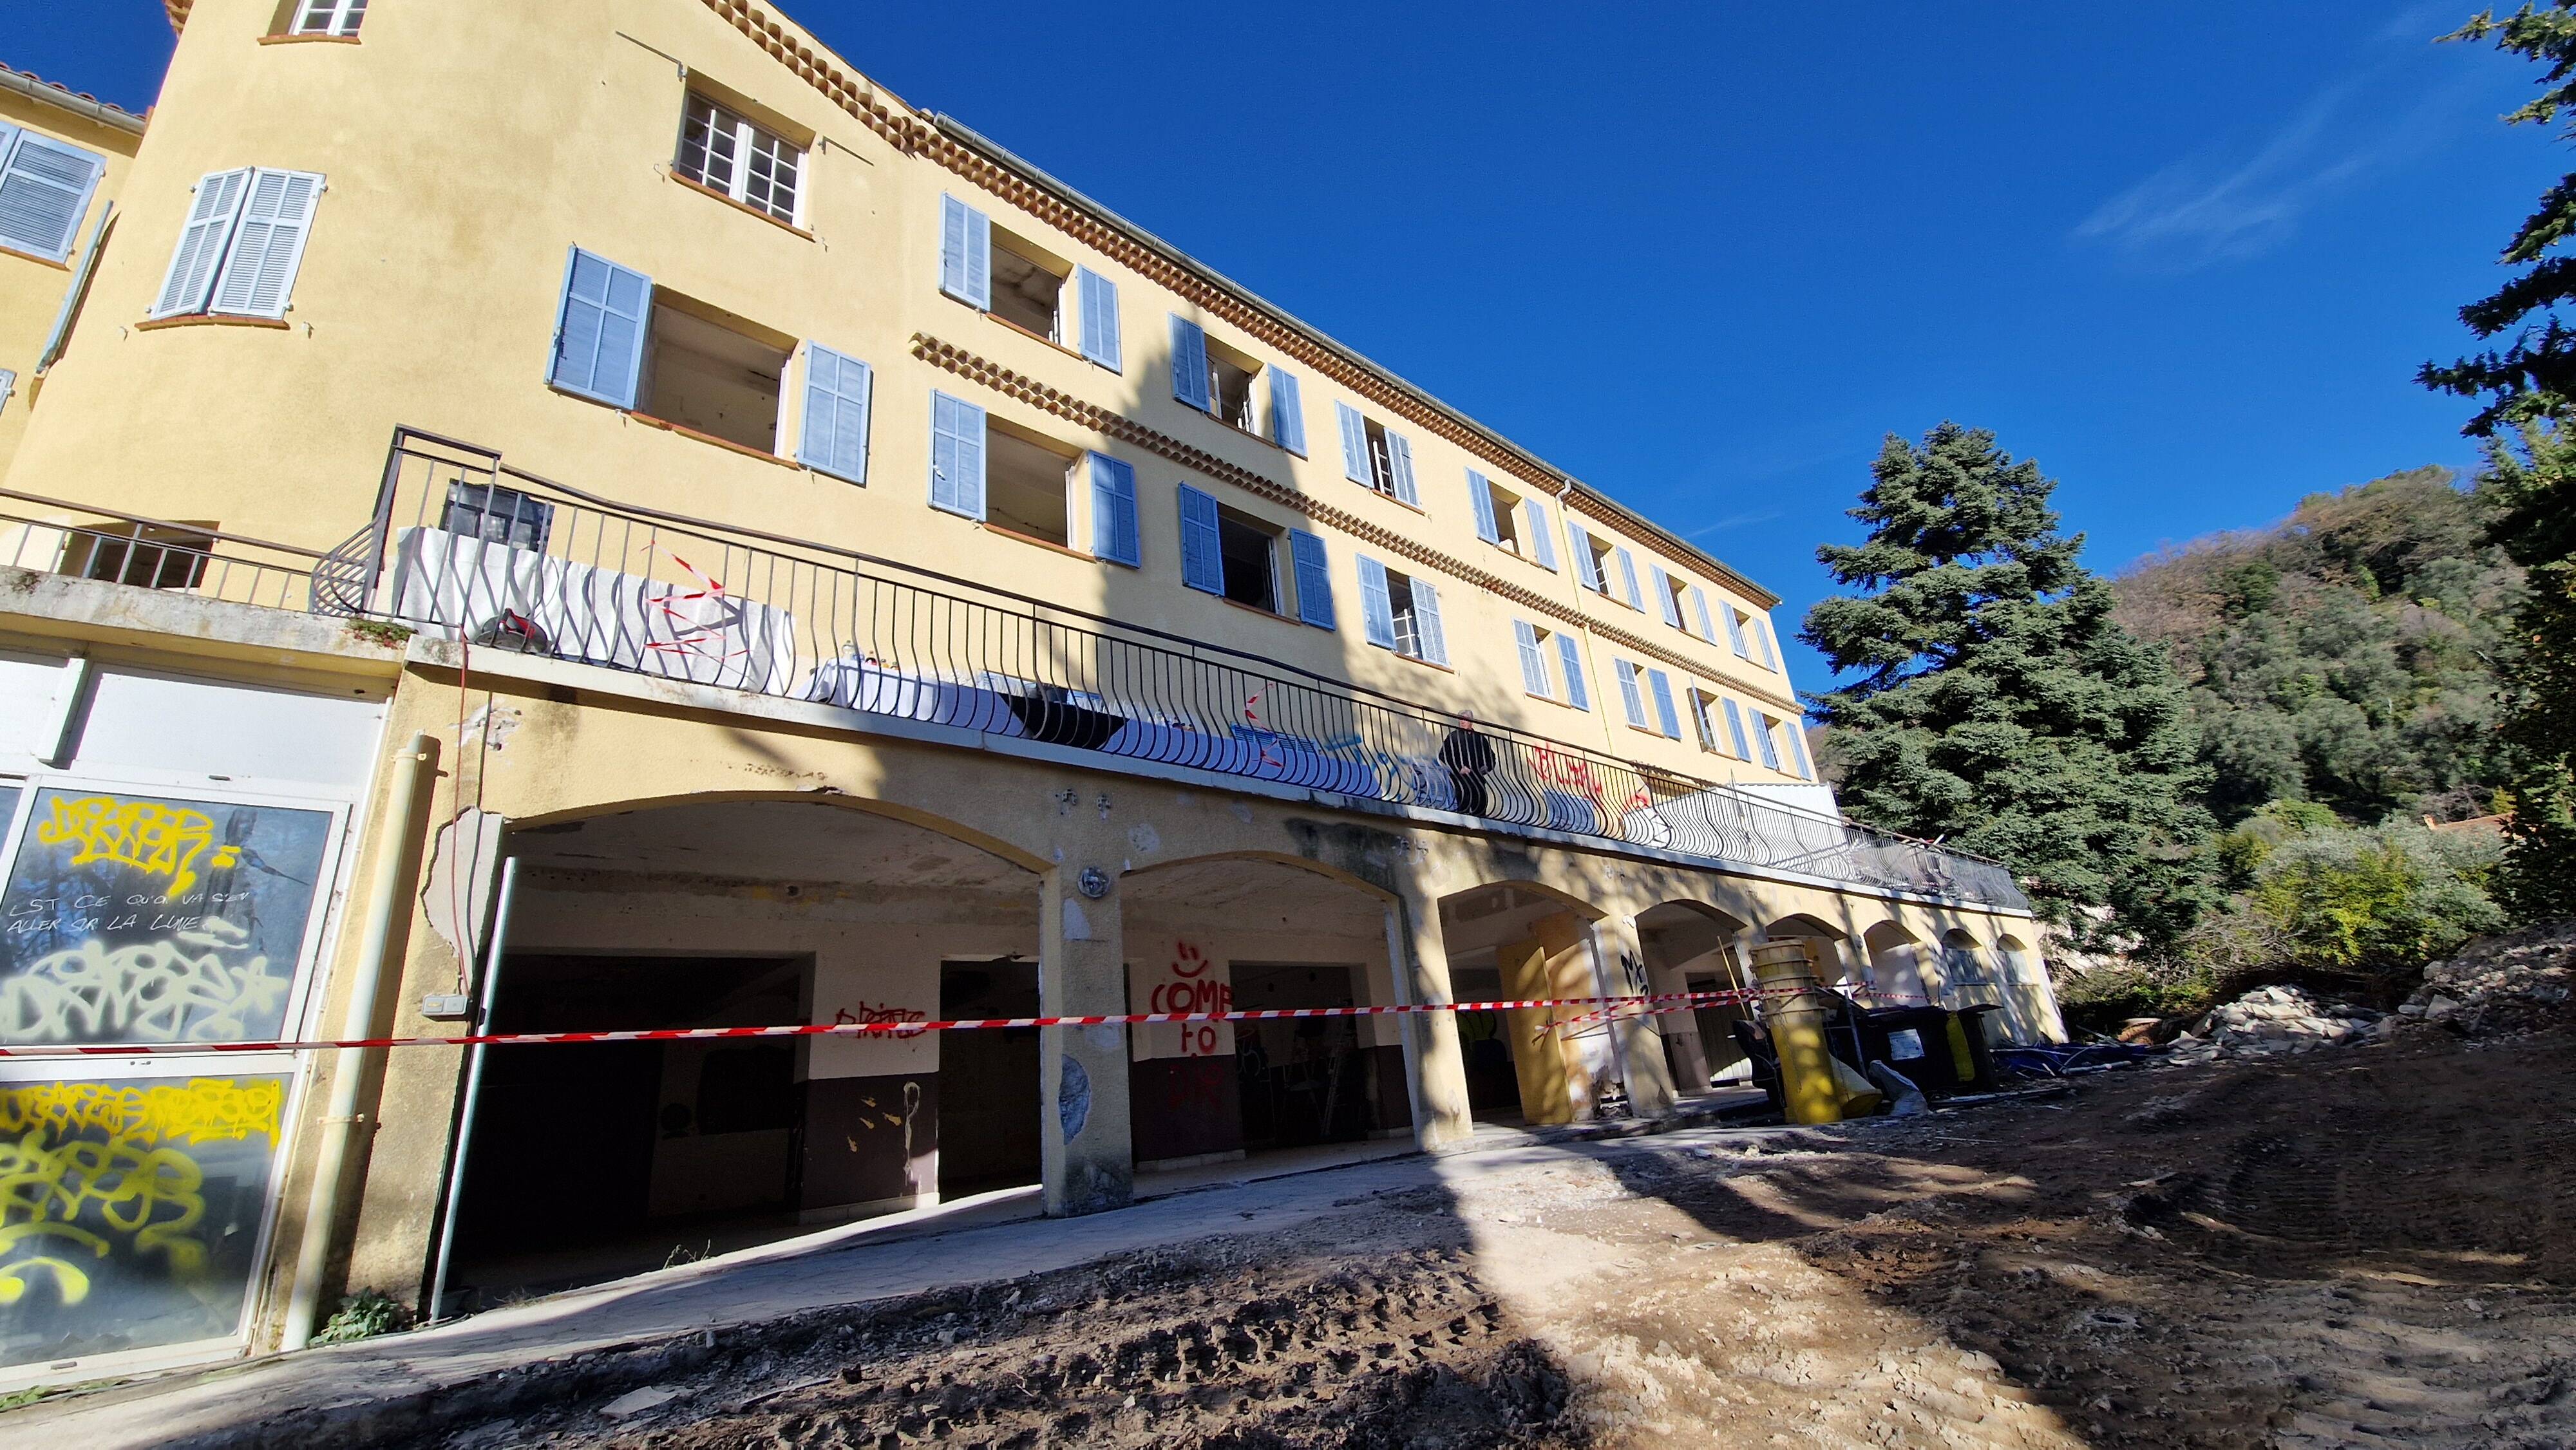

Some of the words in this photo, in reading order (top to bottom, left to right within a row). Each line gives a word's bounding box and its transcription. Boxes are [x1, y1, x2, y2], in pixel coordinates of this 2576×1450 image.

[74, 894, 111, 909] CE
[182, 893, 204, 905] VA
[7, 918, 62, 934] ALLER
[67, 918, 99, 932] SUR
[106, 914, 138, 931] LA
[149, 914, 201, 932] LUNE
